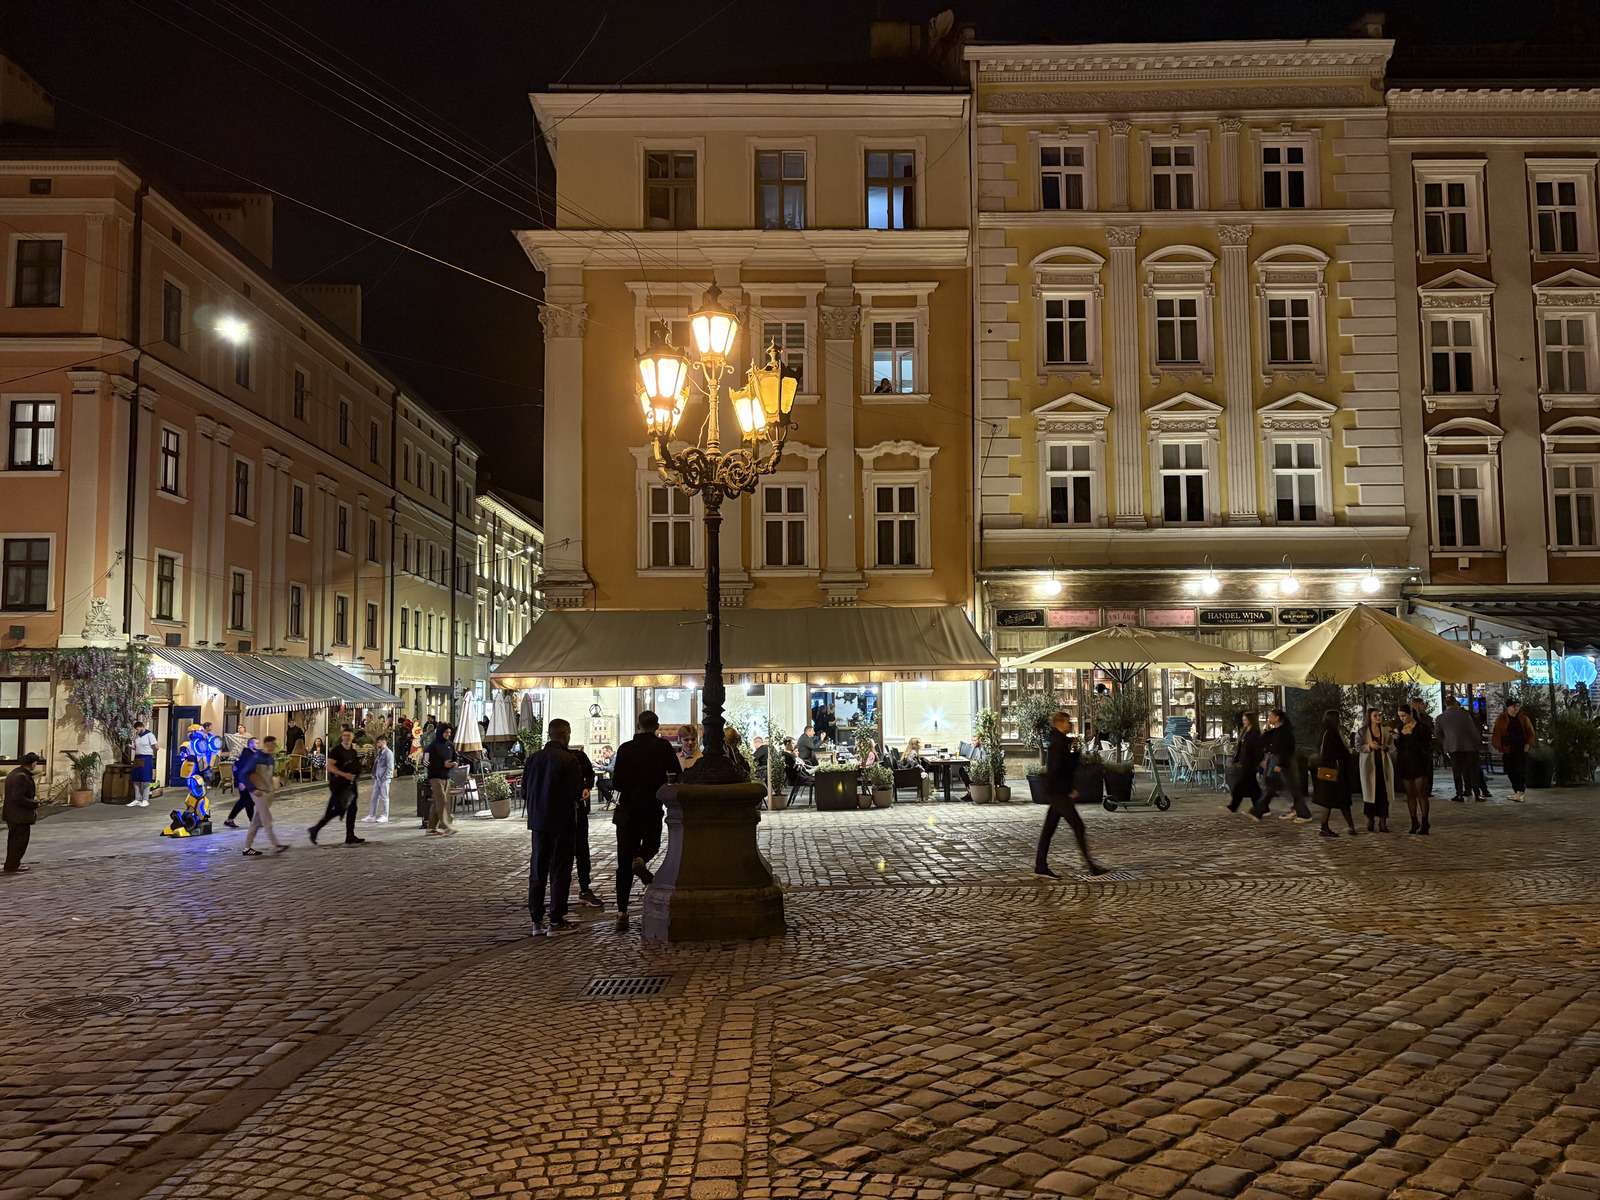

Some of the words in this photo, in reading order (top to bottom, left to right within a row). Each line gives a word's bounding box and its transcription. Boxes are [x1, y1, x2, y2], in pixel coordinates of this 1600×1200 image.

[730, 672, 789, 684] BASILICO
[894, 672, 923, 680] PASTA
[564, 678, 594, 686] PIZZA
